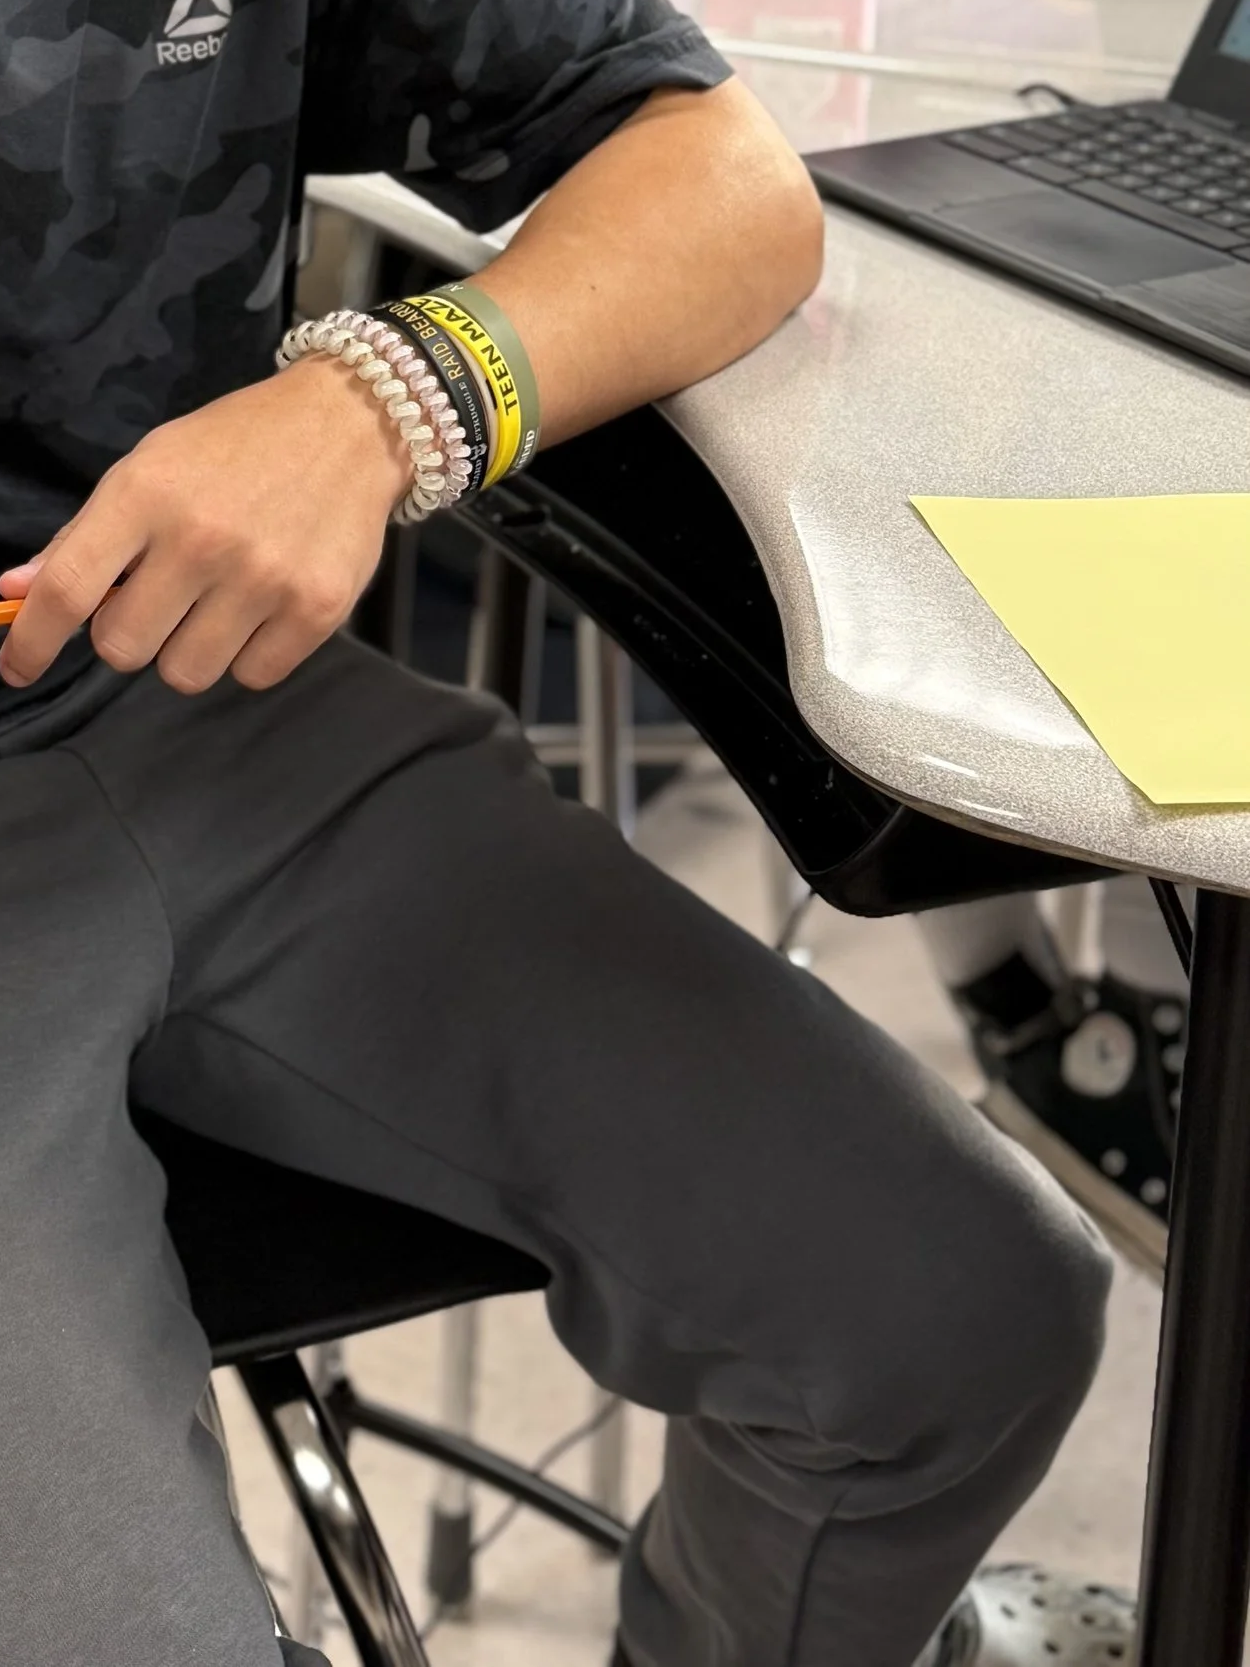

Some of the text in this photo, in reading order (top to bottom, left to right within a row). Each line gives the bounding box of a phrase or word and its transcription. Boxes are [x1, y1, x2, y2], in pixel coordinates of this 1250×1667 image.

[156, 32, 228, 65] Reeb
[415, 297, 486, 342] MAZE
[480, 343, 518, 417] TEEN
[458, 381, 483, 443] STRUGGLE
